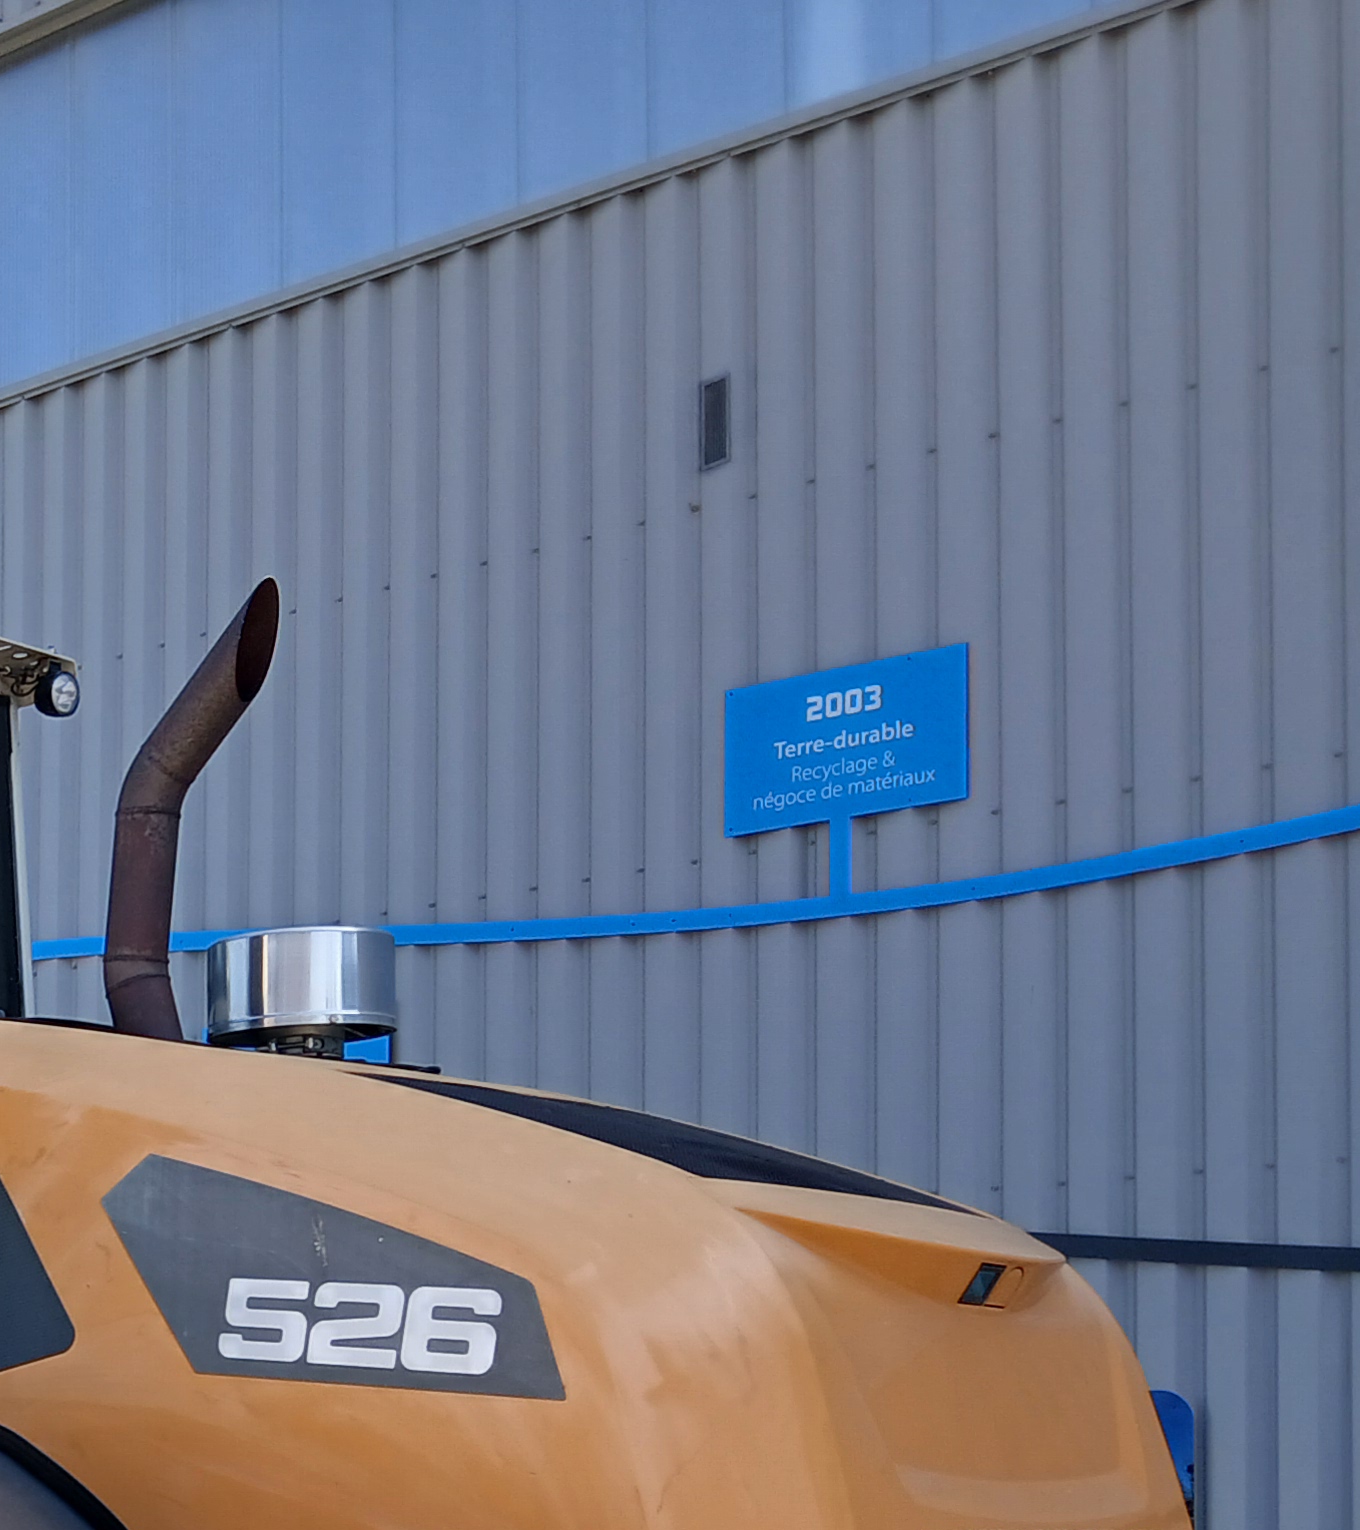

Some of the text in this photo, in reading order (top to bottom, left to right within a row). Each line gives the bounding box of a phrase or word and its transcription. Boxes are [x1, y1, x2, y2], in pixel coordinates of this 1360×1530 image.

[806, 684, 883, 723] 2003
[773, 719, 916, 760] Terre-durable
[791, 750, 896, 785] Recyclage &
[752, 768, 936, 813] négoce de matériaux
[217, 1277, 503, 1376] 526
